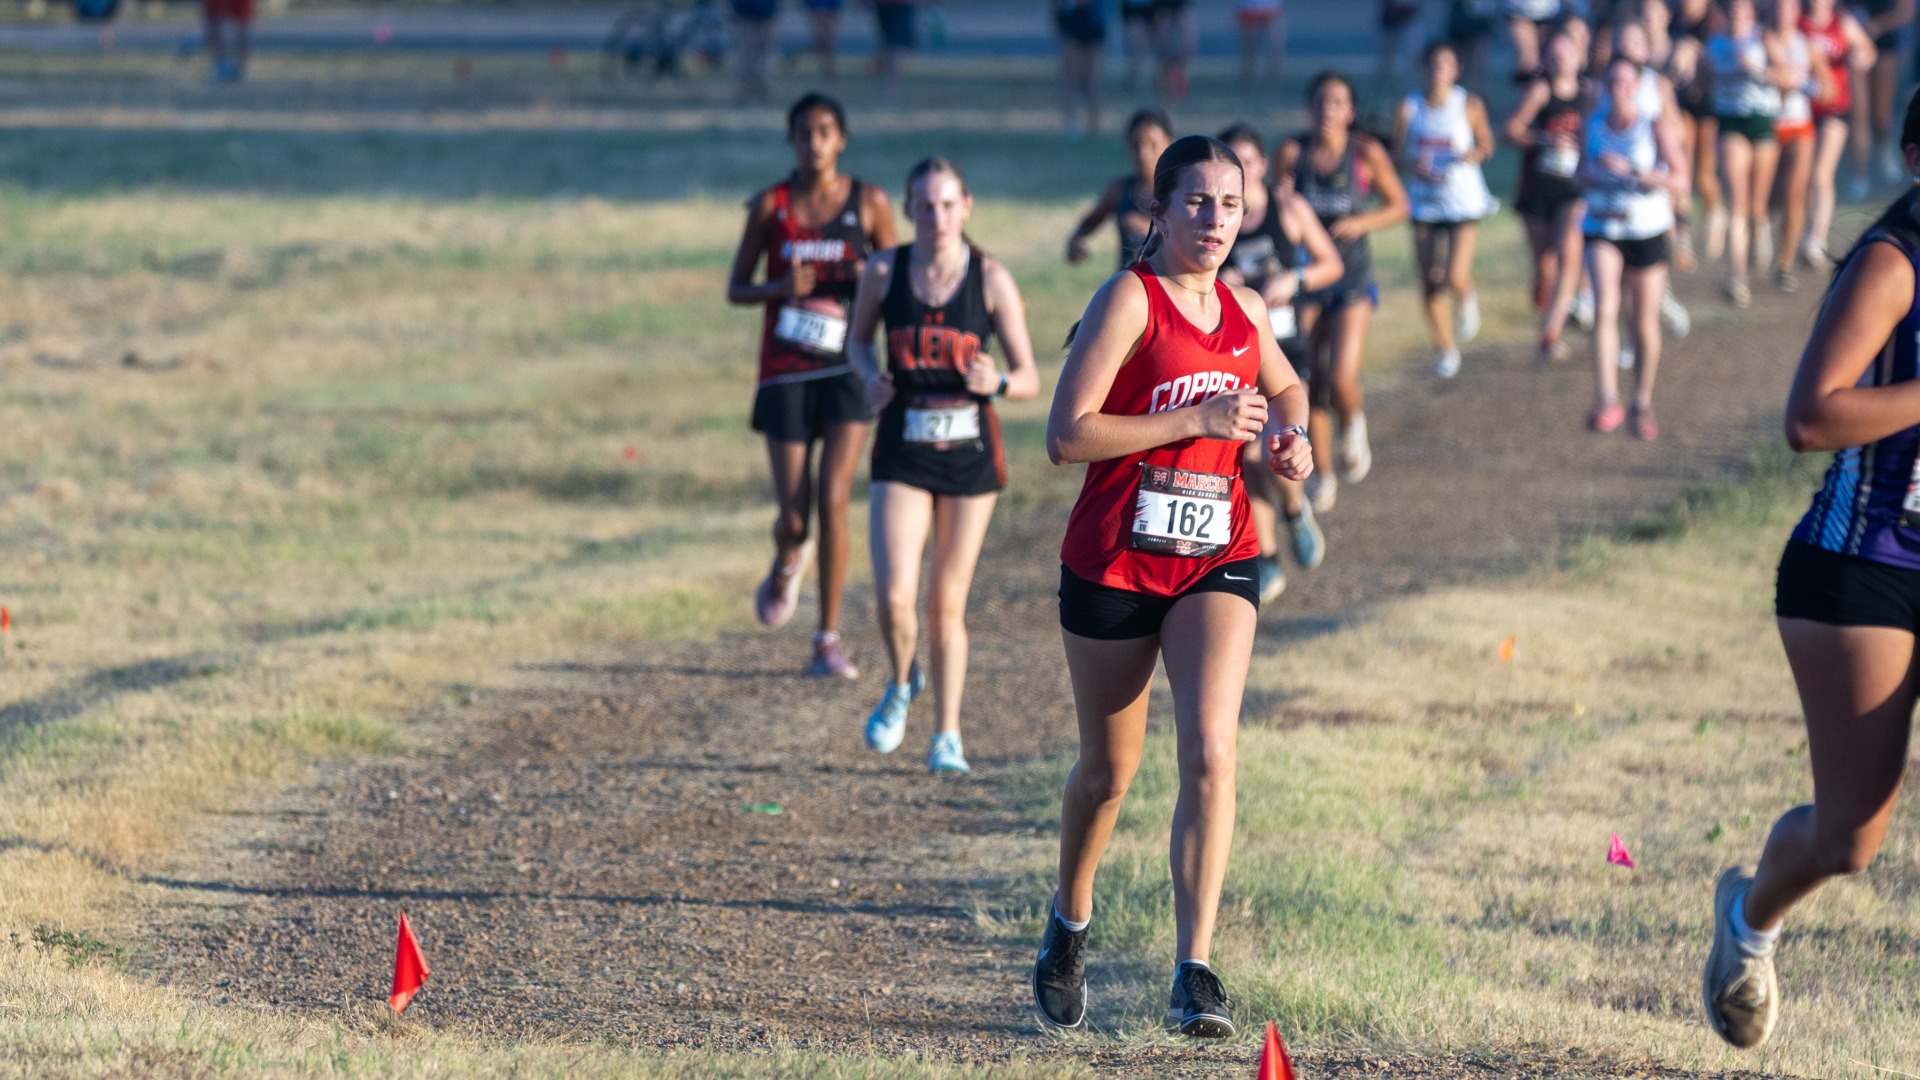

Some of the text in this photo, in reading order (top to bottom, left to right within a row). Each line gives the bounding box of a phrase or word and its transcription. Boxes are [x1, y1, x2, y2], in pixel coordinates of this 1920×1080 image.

[926, 414, 954, 439] 27
[1173, 472, 1229, 493] MARCUS
[1167, 500, 1214, 539] 162
